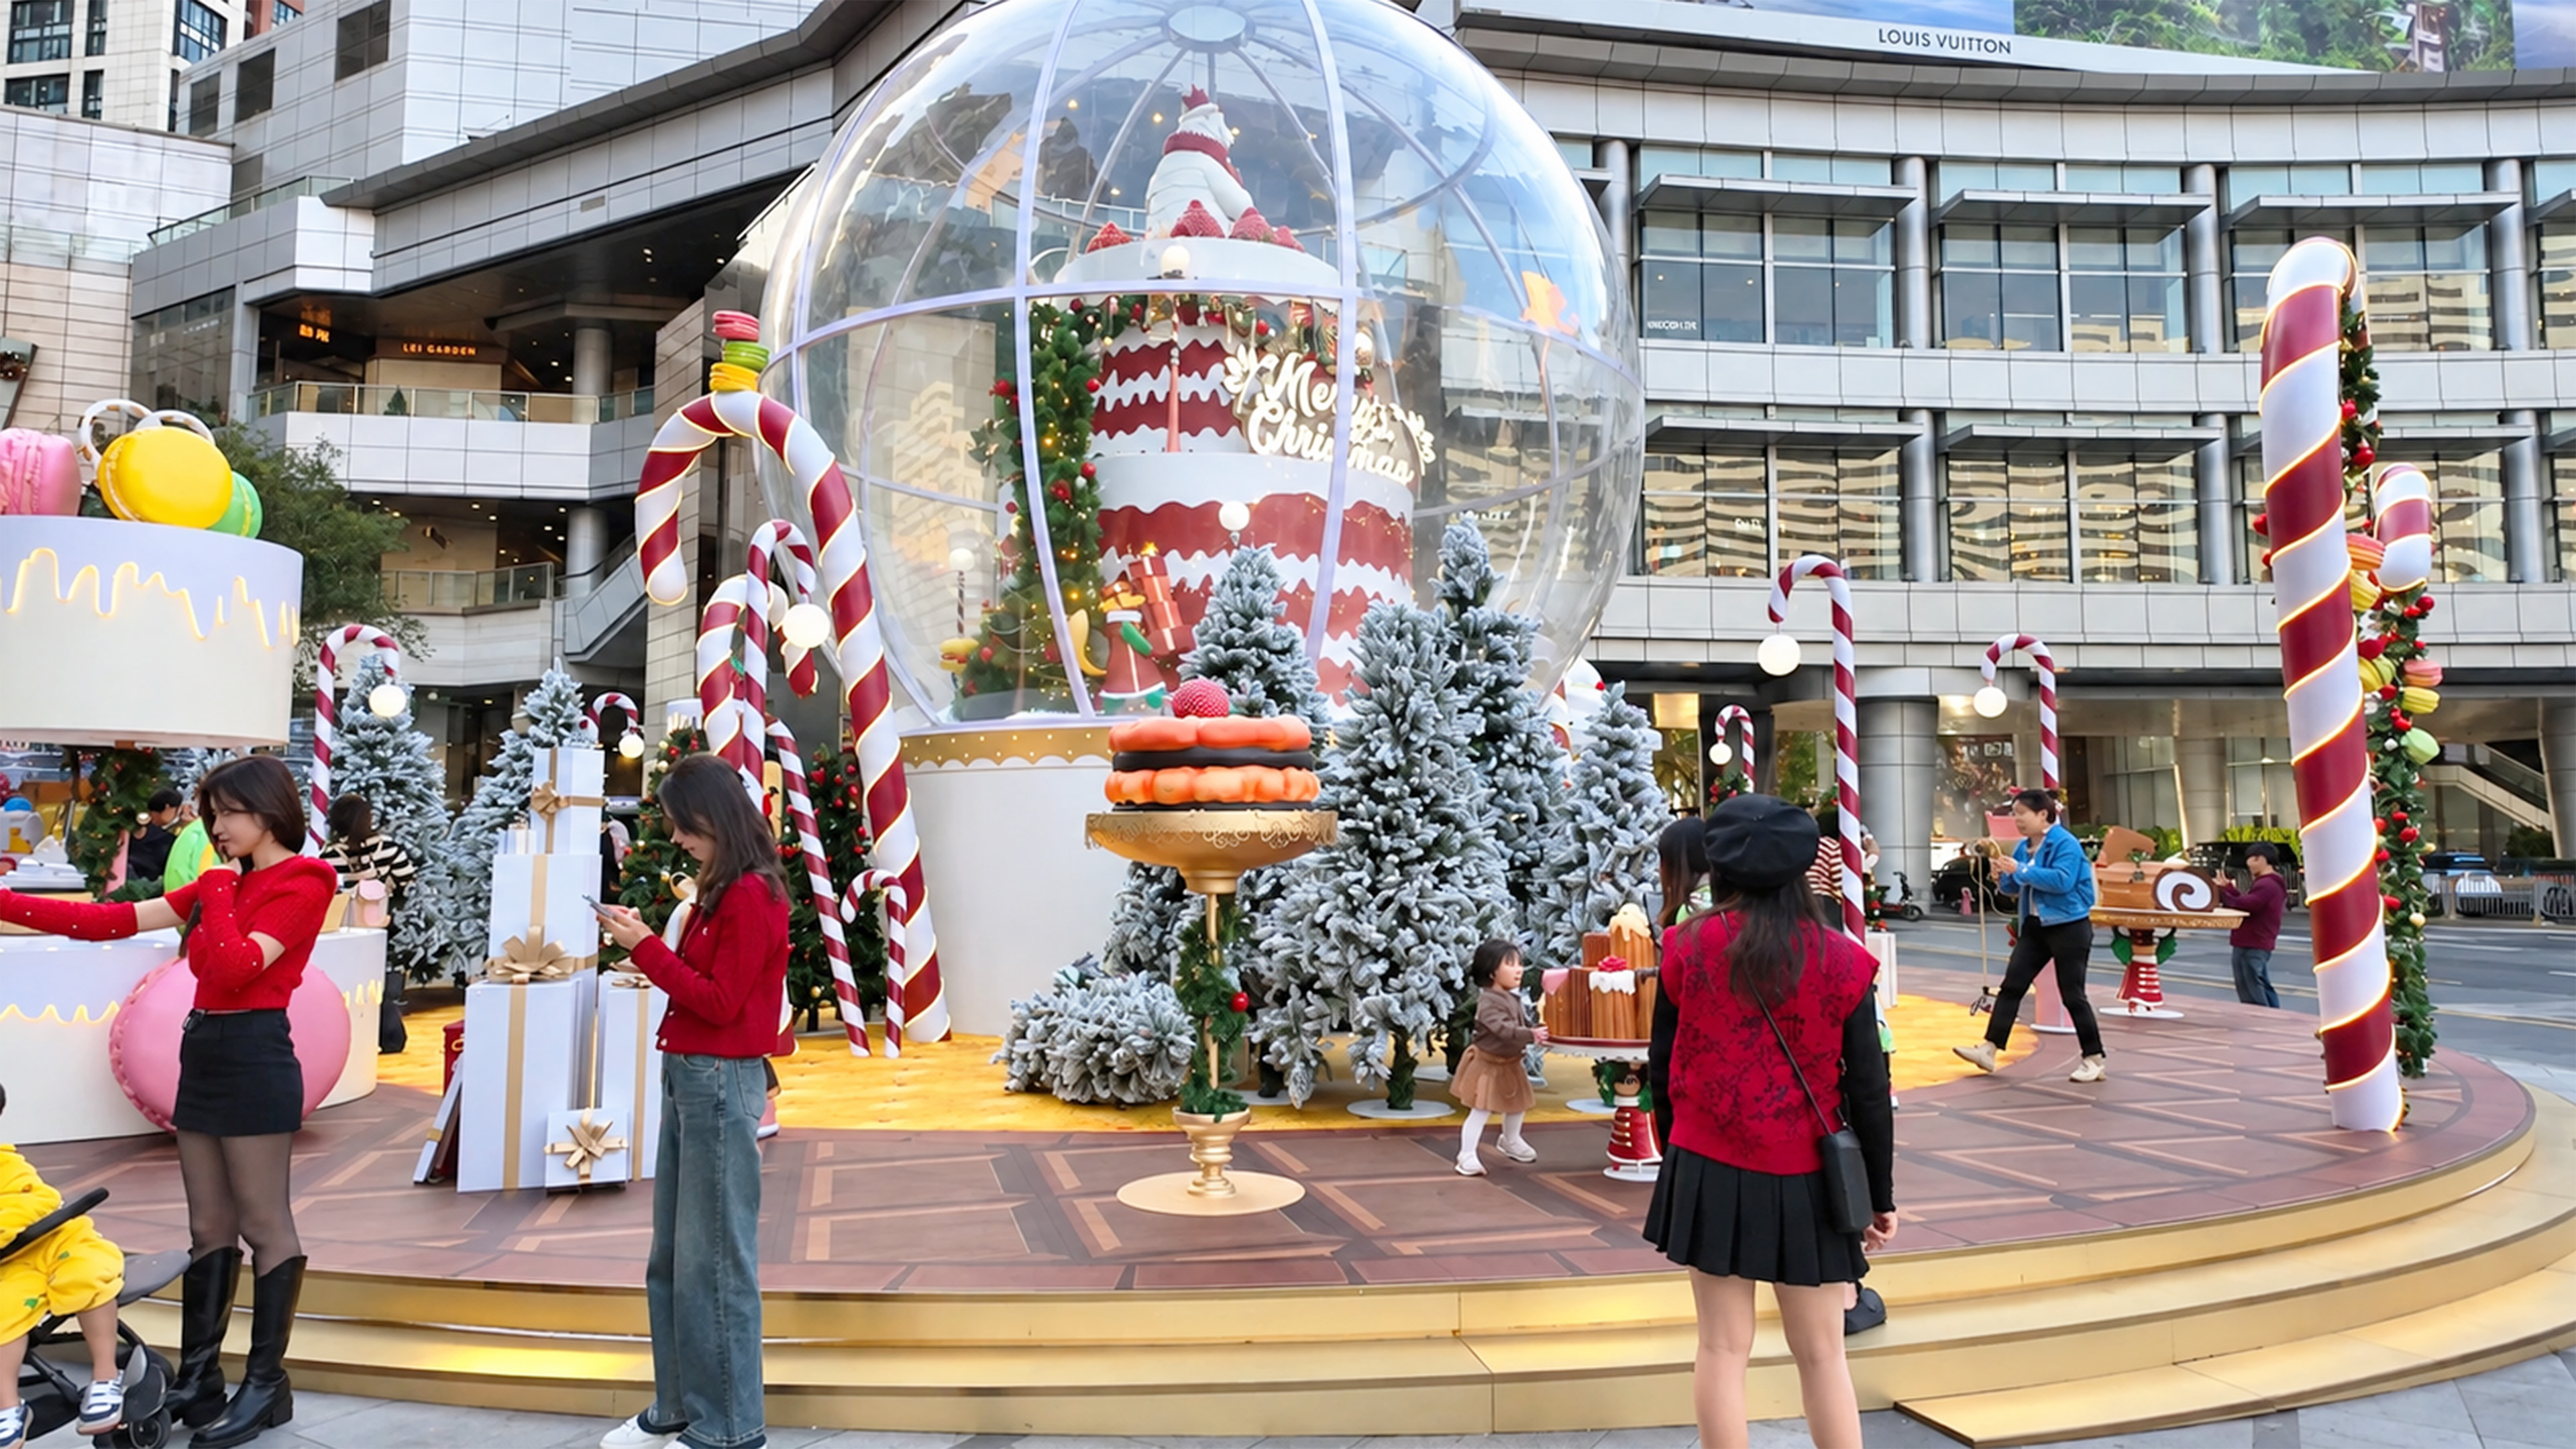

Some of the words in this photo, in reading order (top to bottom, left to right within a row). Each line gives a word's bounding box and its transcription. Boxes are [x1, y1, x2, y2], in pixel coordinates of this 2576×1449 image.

[1879, 28, 1931, 47] LOUIS
[1937, 34, 2011, 54] VUITTON
[403, 343, 422, 353] LEI
[427, 344, 476, 356] GARDEN
